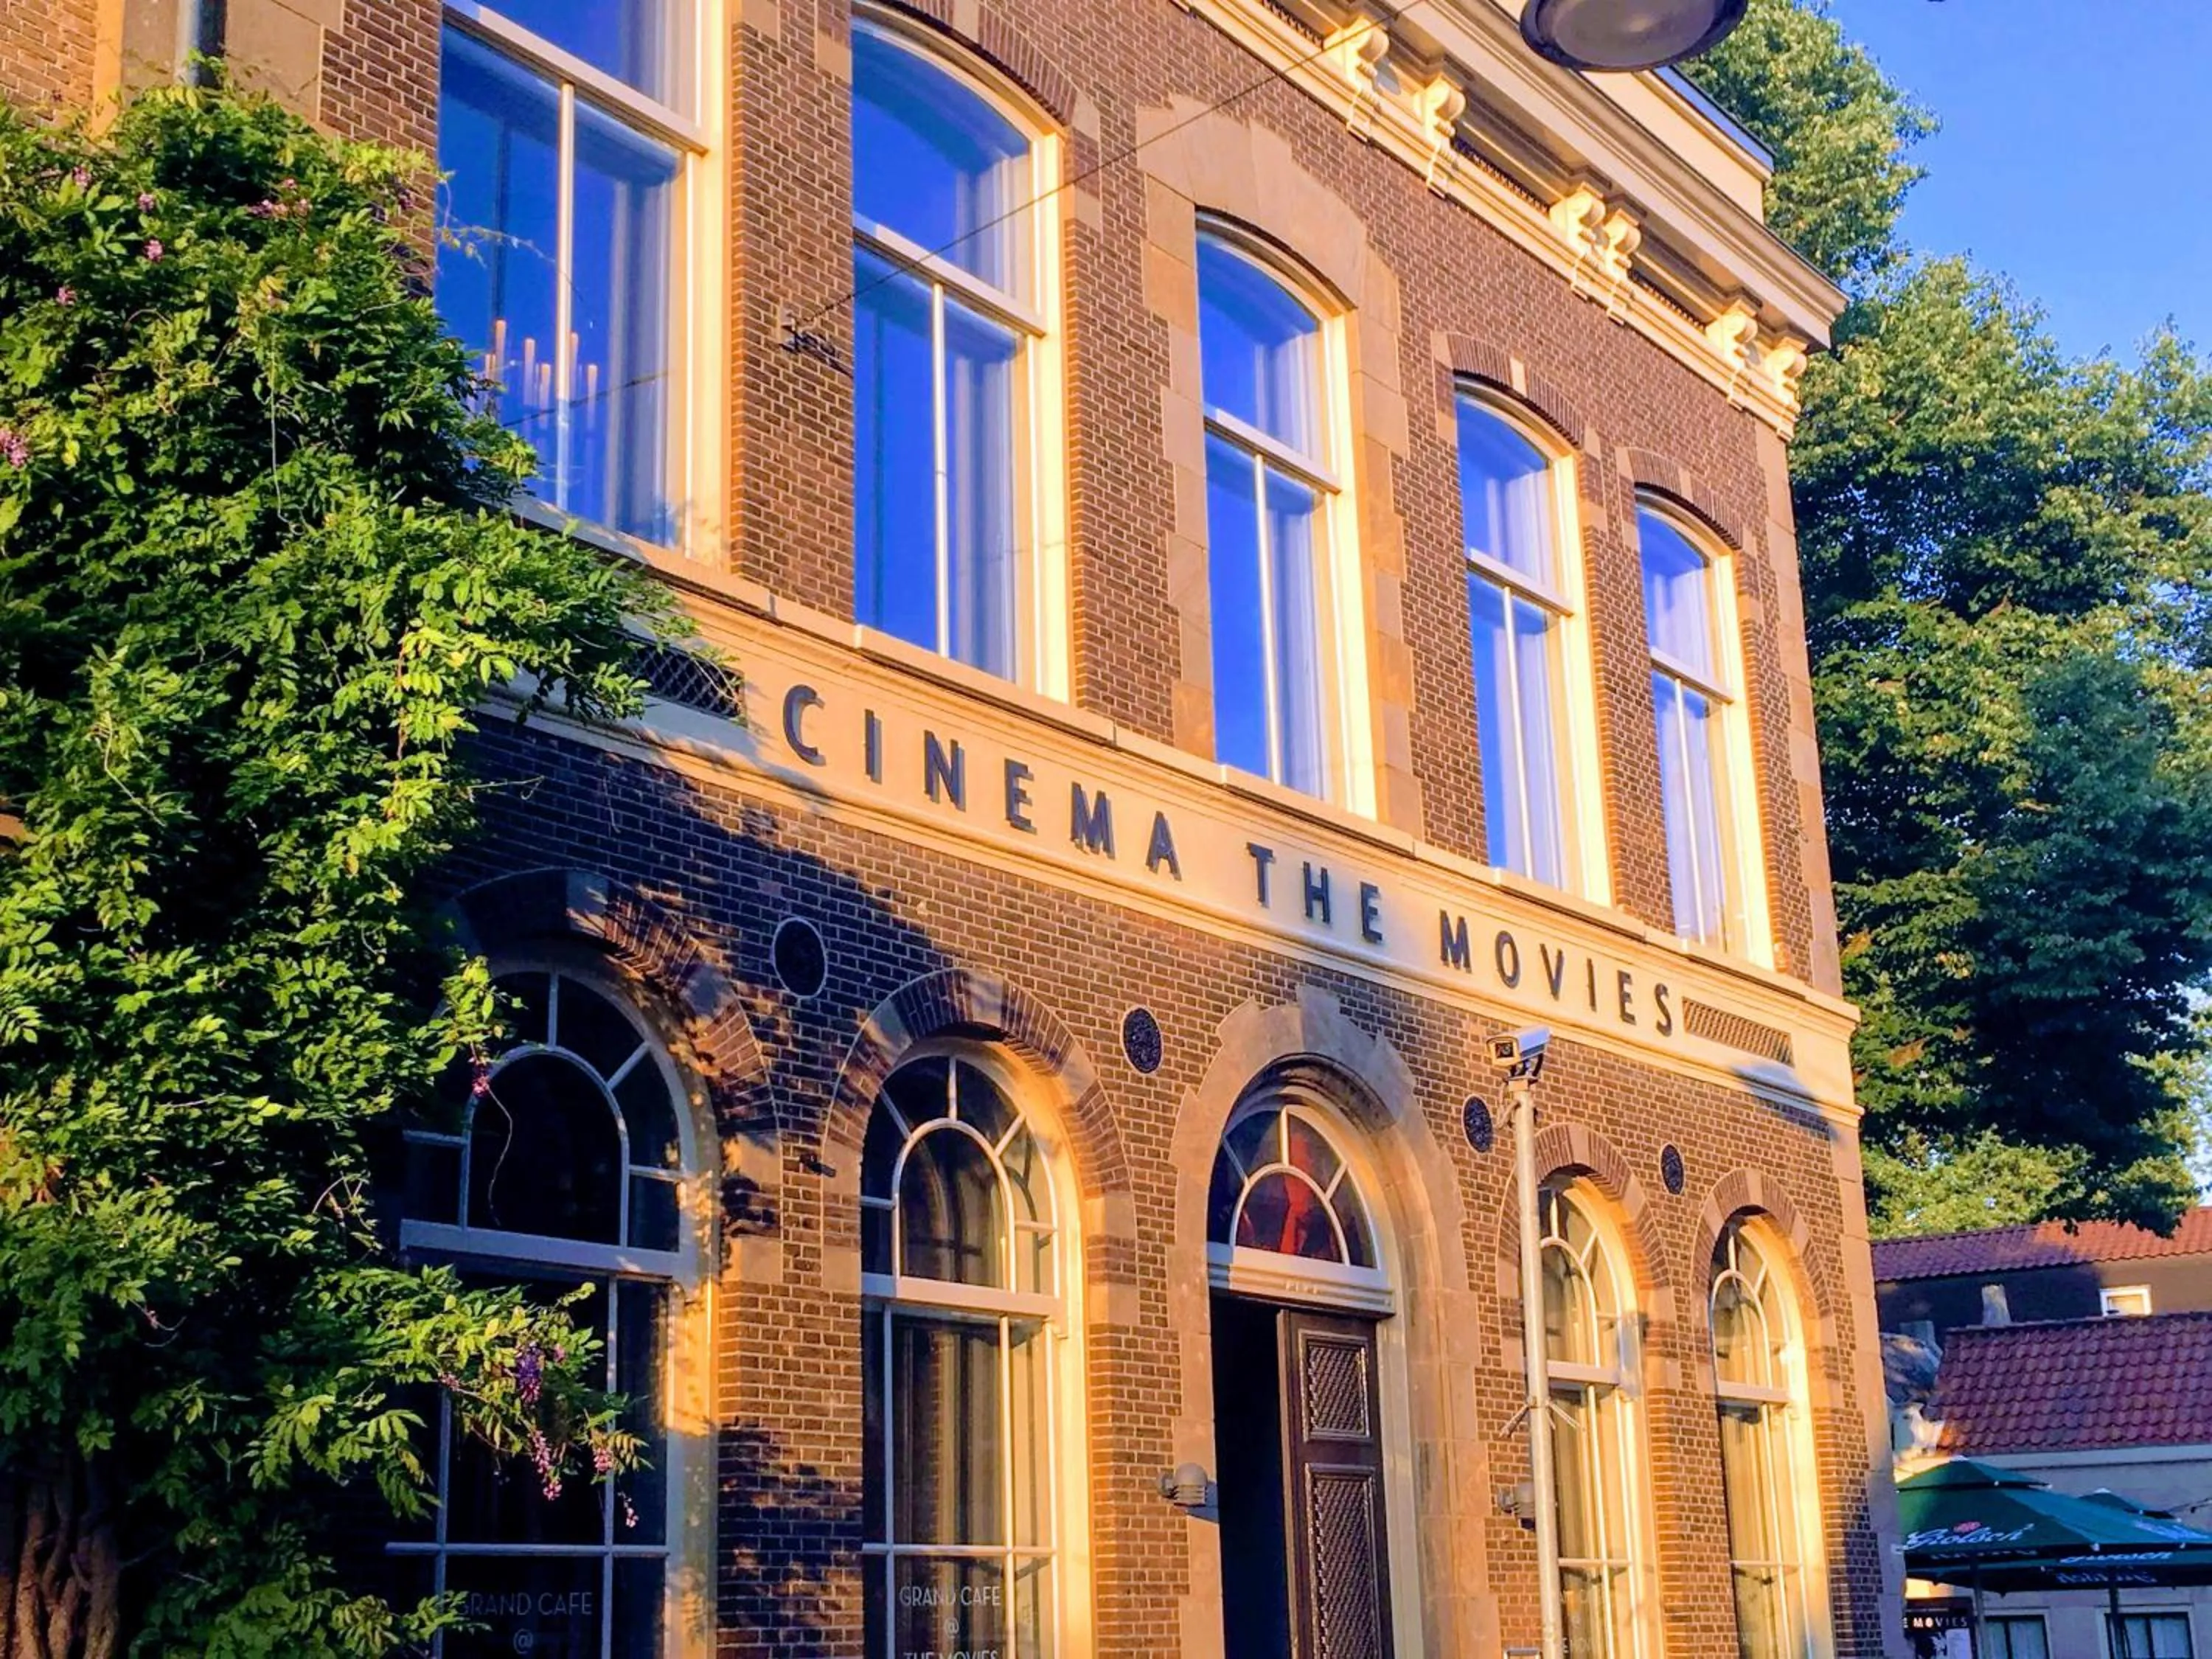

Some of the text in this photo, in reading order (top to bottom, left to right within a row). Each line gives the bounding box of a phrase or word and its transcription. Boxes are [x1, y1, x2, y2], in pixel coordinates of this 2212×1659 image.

[783, 684, 1674, 1037] CINEMA THE MOVIES
[538, 1592, 594, 1615] CAFE
[900, 1585, 1001, 1607] GRAND CAFE
[944, 1618, 959, 1639] @
[1913, 1616, 1968, 1629] MOVIES
[512, 1628, 534, 1655] @
